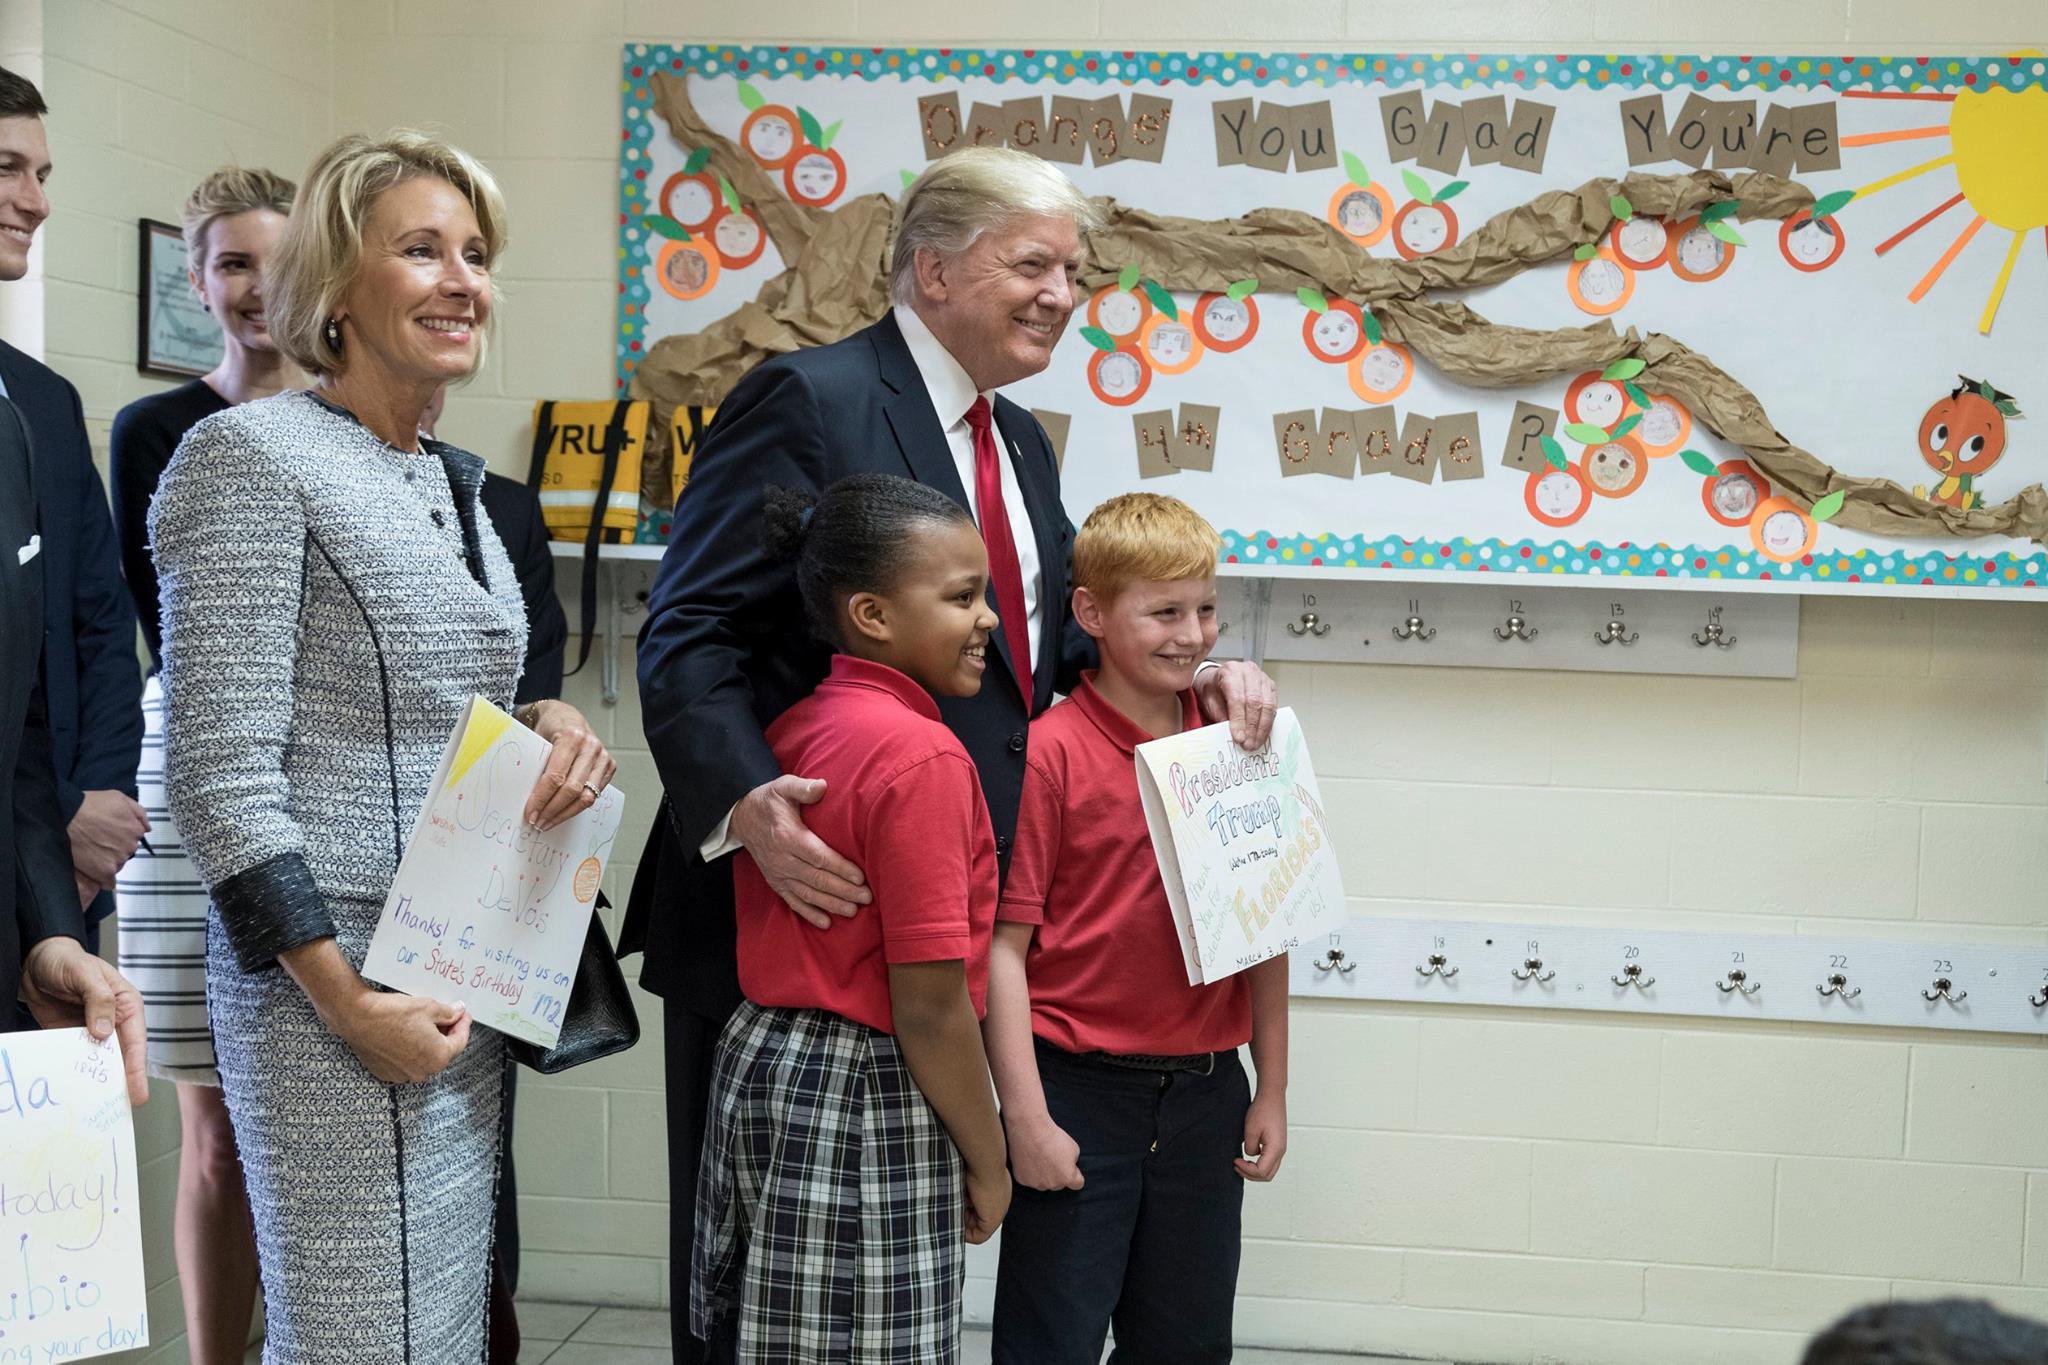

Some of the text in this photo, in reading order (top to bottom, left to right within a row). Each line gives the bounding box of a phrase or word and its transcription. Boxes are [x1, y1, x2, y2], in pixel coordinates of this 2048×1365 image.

[1220, 108, 1327, 157] You
[1391, 105, 1542, 159] Glad
[1630, 109, 1829, 157] You're
[1142, 413, 1544, 465] 4th Grade ?
[1302, 592, 1317, 608] 10
[1408, 599, 1419, 614] 11
[1510, 600, 1525, 614] 12
[1611, 603, 1625, 617] 13
[1168, 737, 1280, 819] President
[1205, 795, 1282, 846] Trump
[394, 893, 449, 947] Thanks!
[485, 946, 530, 981] visiting
[535, 965, 551, 980] us
[553, 971, 570, 989] on
[1527, 940, 1539, 953] 19
[1624, 945, 1640, 959] 20
[1731, 951, 1745, 964] 21
[1829, 954, 1849, 970] 22
[1933, 959, 1954, 974] 23
[469, 965, 524, 1007] Birthday
[73, 1060, 108, 1084] 1845
[0, 1135, 119, 1251] today!
[41, 1335, 90, 1364] your
[96, 1312, 145, 1351] day!
